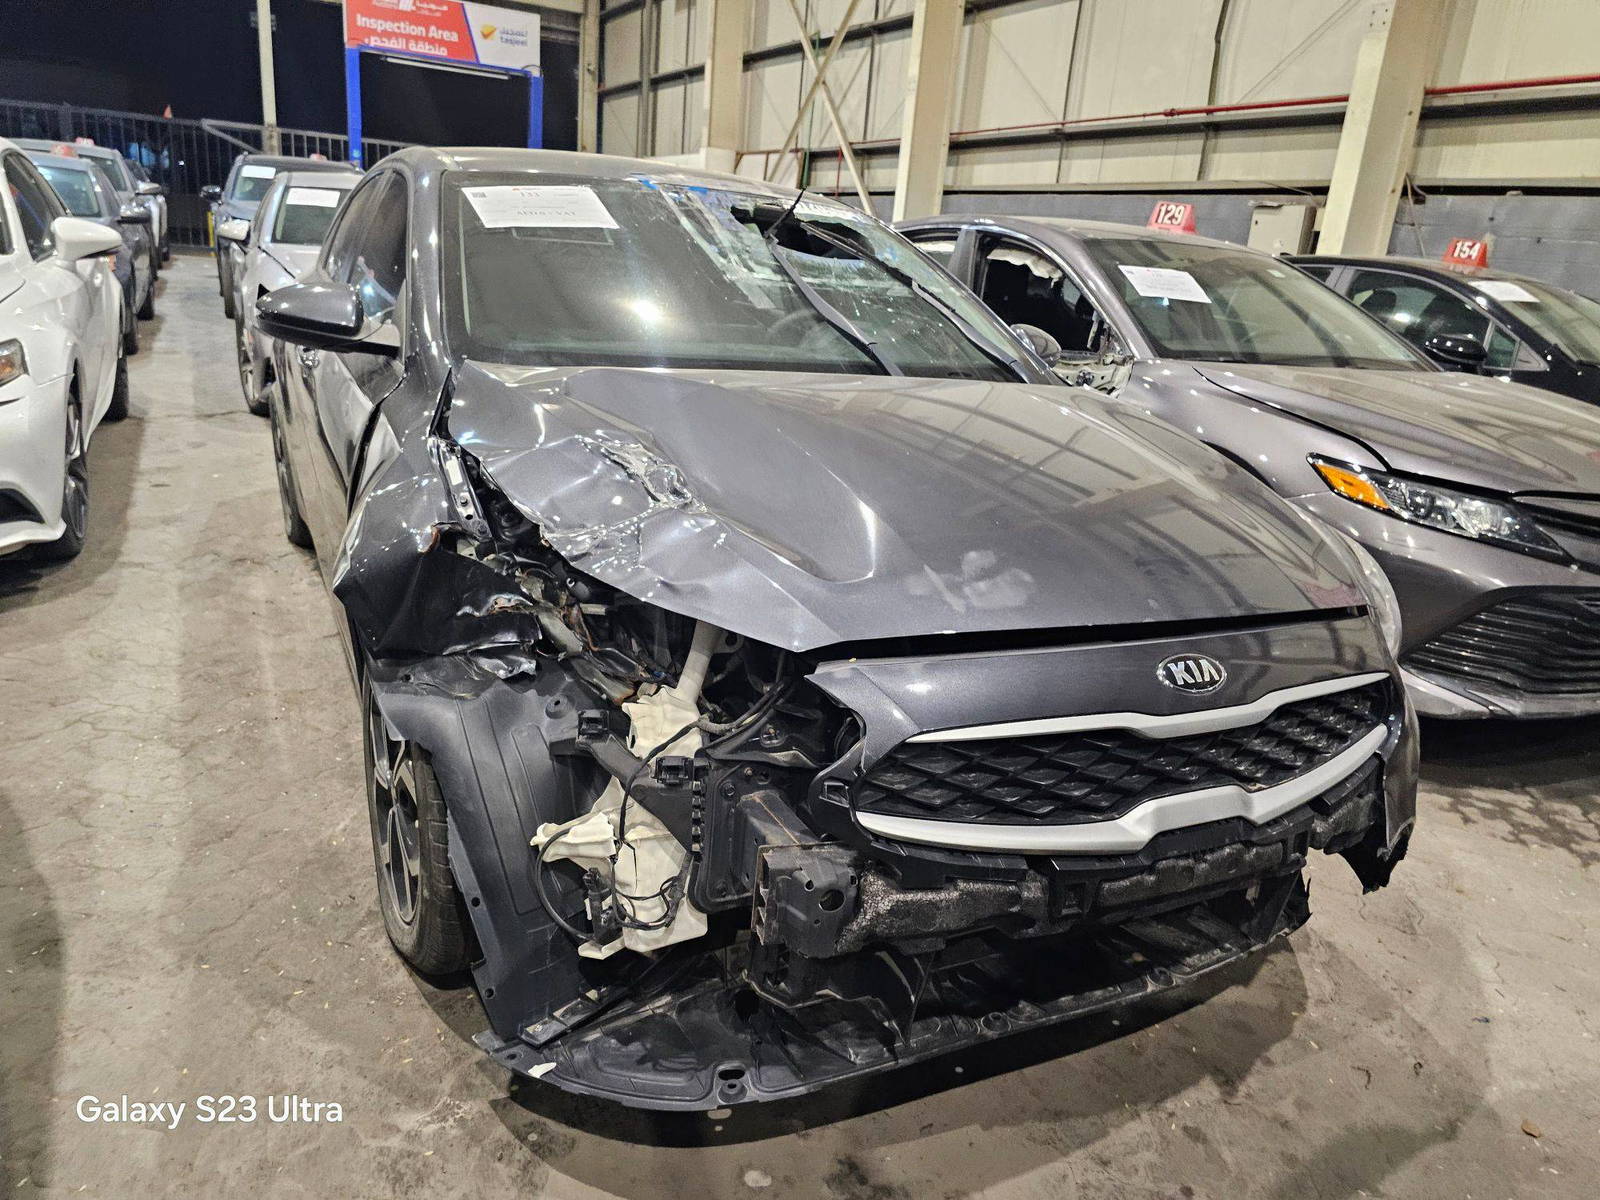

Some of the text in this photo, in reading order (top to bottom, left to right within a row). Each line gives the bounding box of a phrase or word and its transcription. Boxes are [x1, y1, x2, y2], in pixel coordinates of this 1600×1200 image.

[356, 13, 459, 42] Inspection Area
[408, 40, 448, 56] منطقة
[1156, 203, 1185, 226] 129
[1453, 240, 1481, 260] 154
[1167, 659, 1220, 685] KIA
